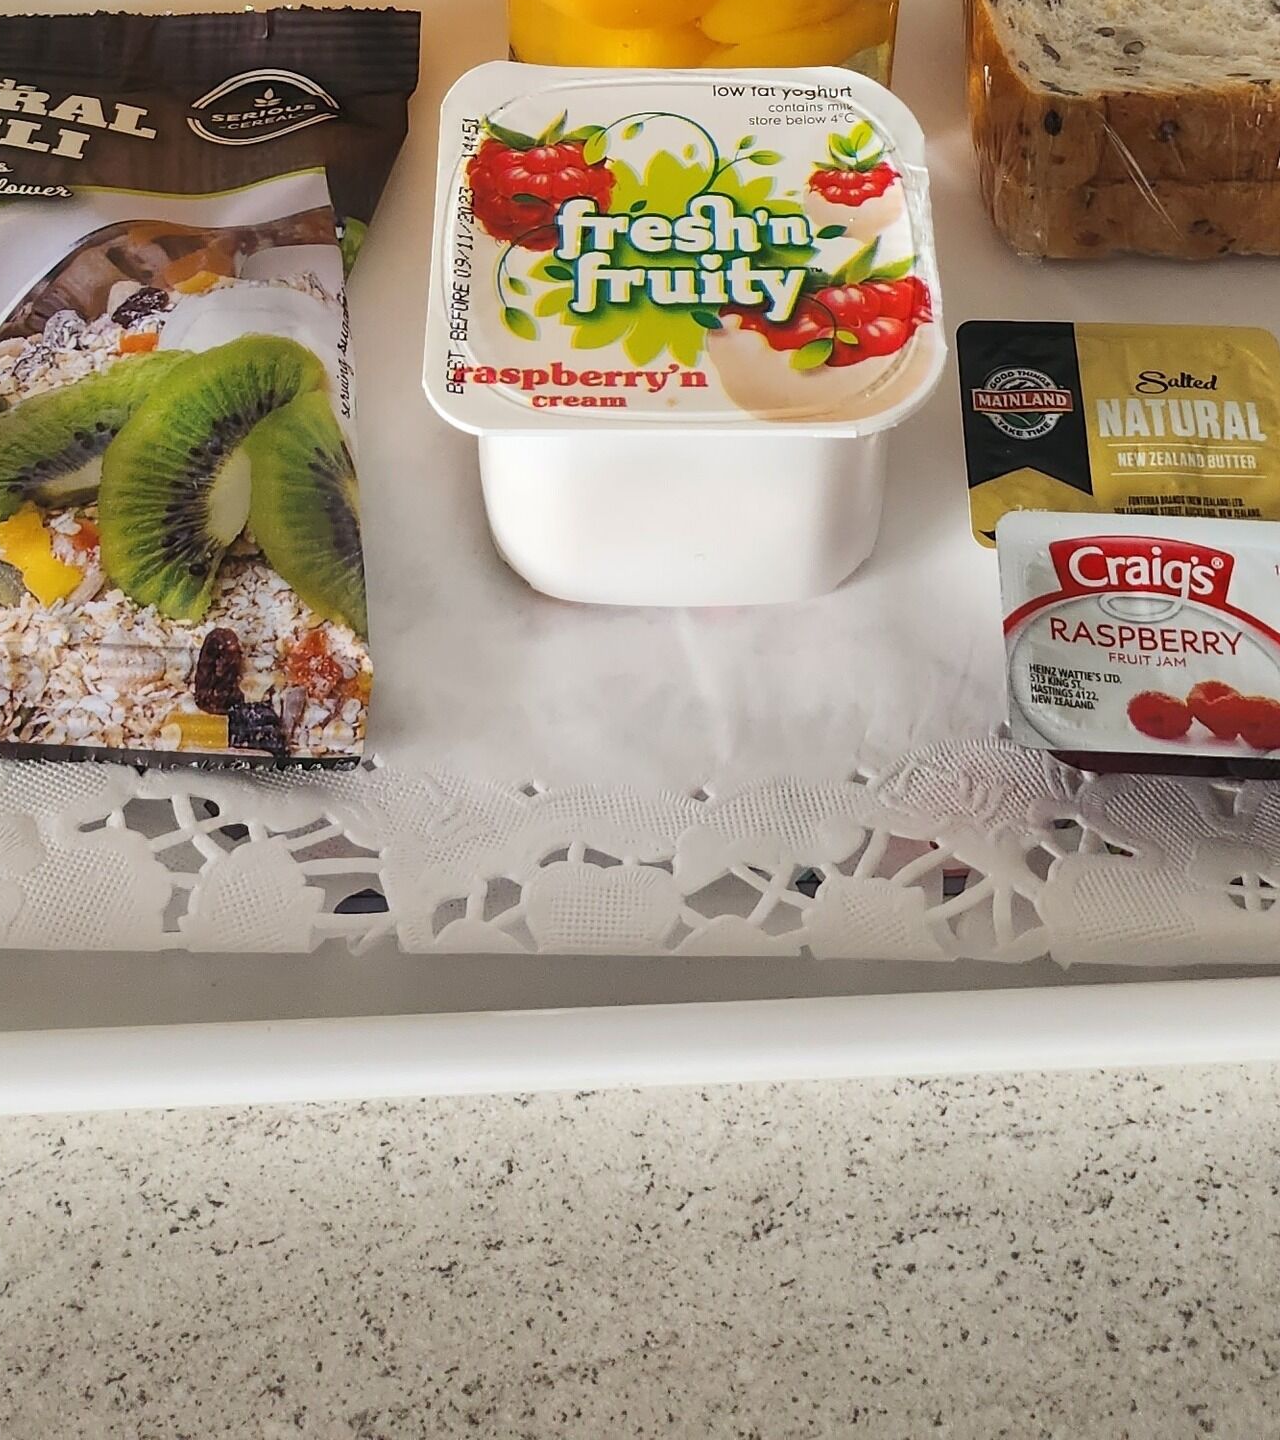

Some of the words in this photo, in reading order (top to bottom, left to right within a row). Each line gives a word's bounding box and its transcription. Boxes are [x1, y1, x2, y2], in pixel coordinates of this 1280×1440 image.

[713, 84, 745, 97] low
[751, 86, 776, 97] fat
[782, 85, 852, 100] yoghurt
[210, 104, 317, 122] SERIOUS
[768, 102, 824, 113] contains
[749, 115, 782, 125] store
[785, 115, 826, 125] below
[831, 112, 855, 124] 4°C
[461, 118, 480, 160] 14:51
[454, 187, 475, 278] 09/11/2023
[555, 196, 810, 256] fresh'n
[571, 254, 807, 323] fruity
[449, 281, 470, 341] BEFORE
[445, 349, 466, 395] BEST
[454, 362, 708, 393] raspberry'n
[989, 371, 1015, 389] GOOD
[1017, 370, 1051, 387] THINGS
[1135, 371, 1218, 394] Salted
[532, 394, 627, 408] cream
[976, 393, 1067, 407] MAINLAND
[998, 420, 1023, 437] TAKE
[1024, 421, 1051, 437] TIME
[1095, 399, 1268, 442] NATURAL
[1117, 452, 1147, 467] NEW
[1149, 451, 1205, 468] ZEALAND
[1207, 454, 1257, 469] BUTTER
[1049, 617, 1244, 656] RASPBERRY
[1109, 652, 1152, 666] FRUIT
[1156, 656, 1187, 667] JAM
[1029, 663, 1057, 675] HEINZ
[1058, 668, 1101, 682] WATTIE'S
[1031, 684, 1074, 698] HASTINGS
[1047, 676, 1069, 688] KING
[1031, 694, 1052, 705] NEW
